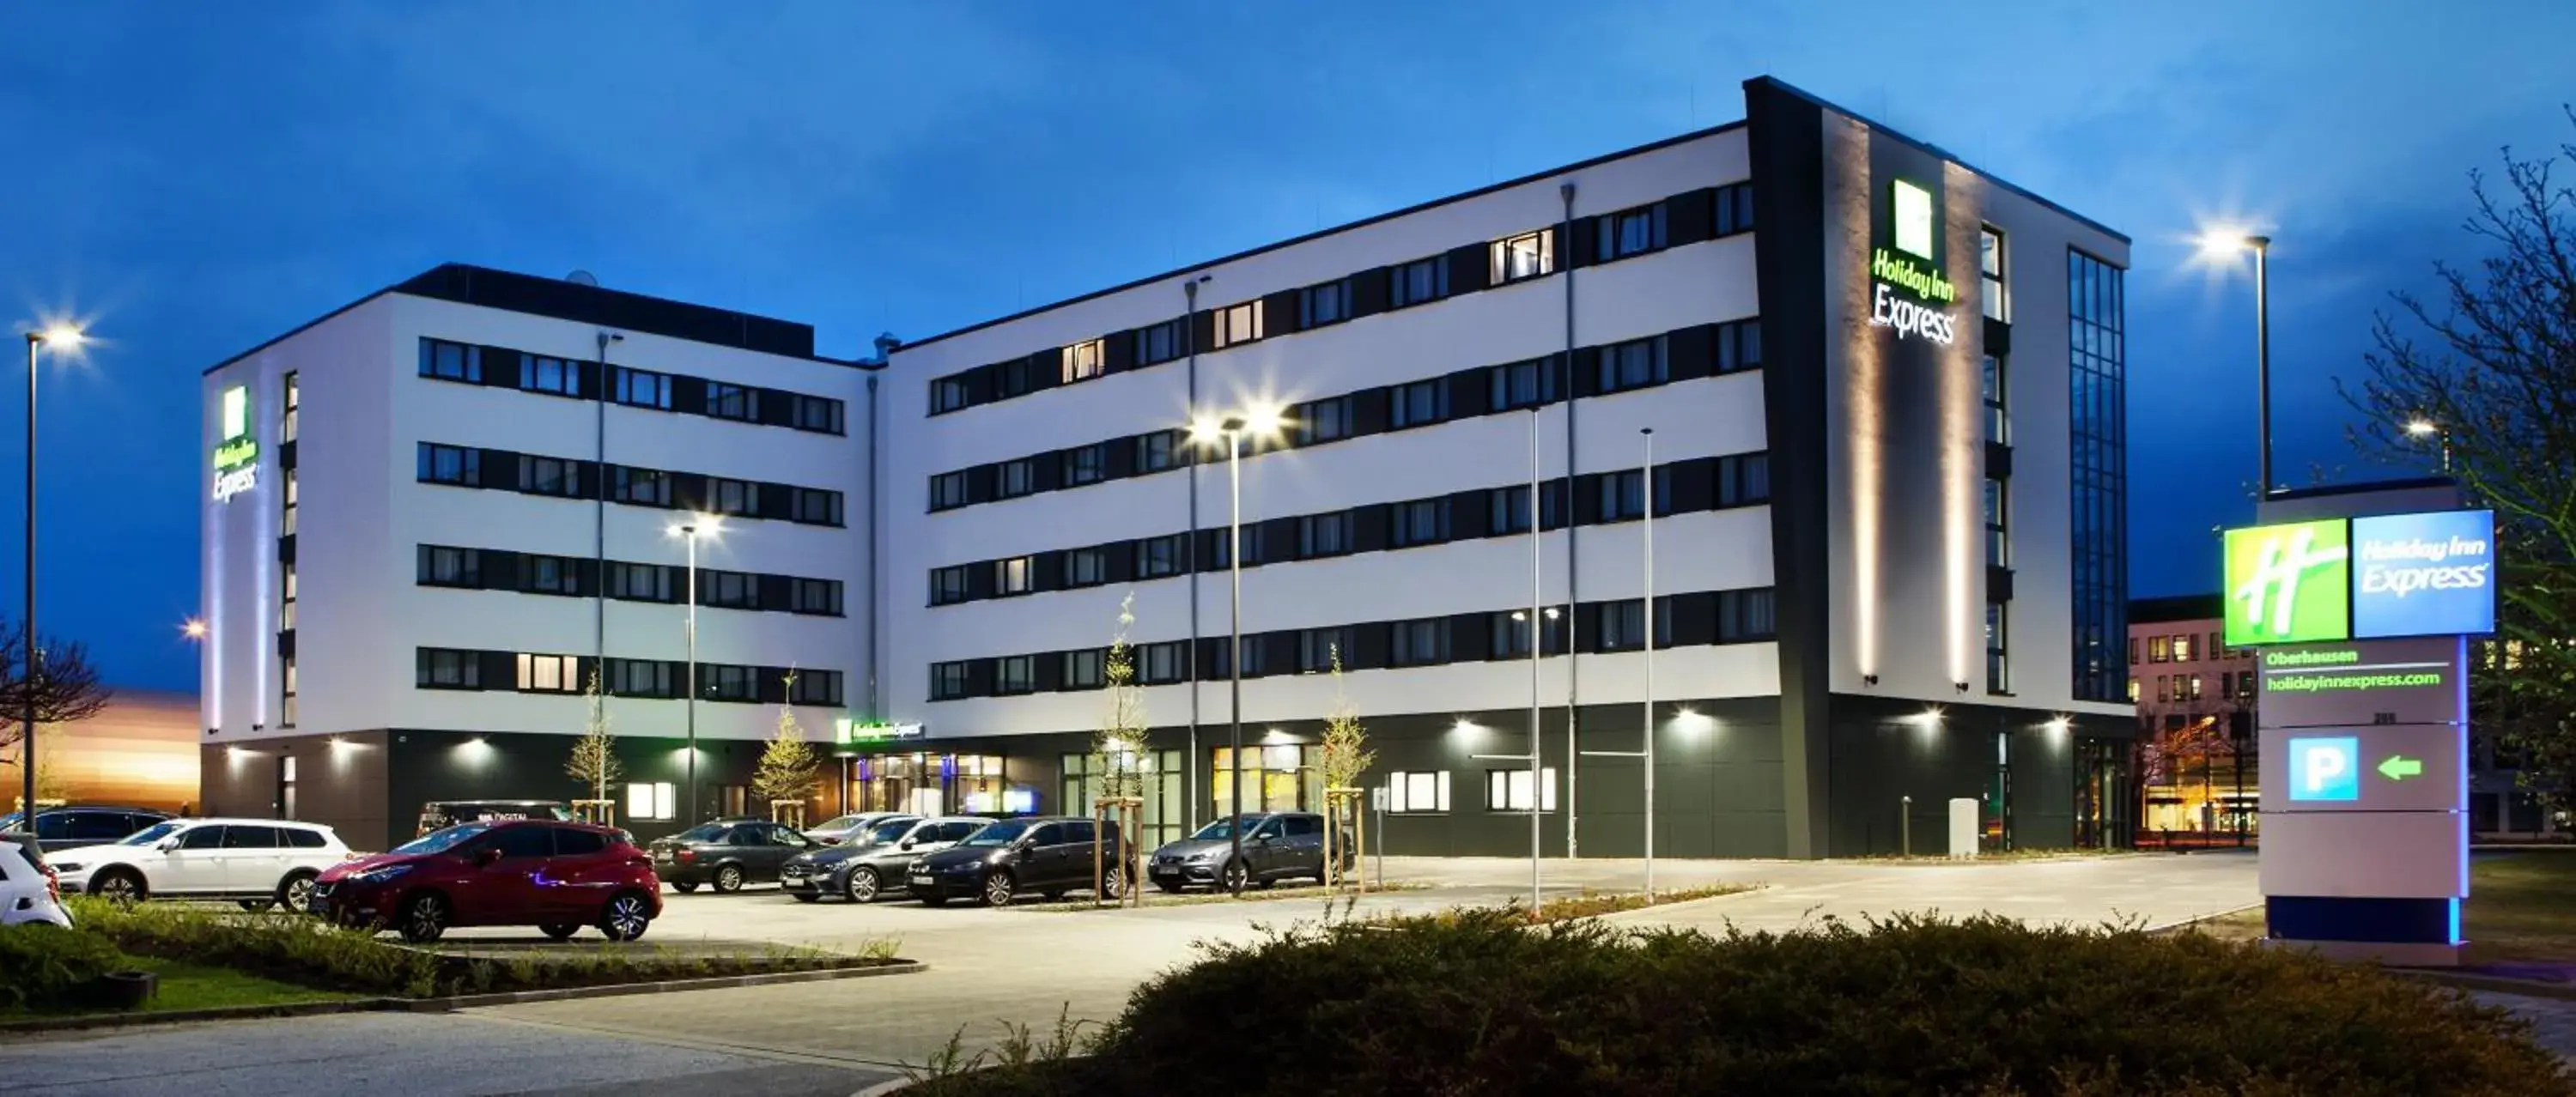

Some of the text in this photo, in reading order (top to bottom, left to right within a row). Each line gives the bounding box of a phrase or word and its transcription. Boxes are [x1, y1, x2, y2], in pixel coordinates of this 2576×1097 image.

[1873, 248, 1954, 302] Holiday Inn
[1872, 282, 1956, 344] Express
[2361, 535, 2486, 562] Holiday Inn
[2362, 562, 2489, 597] Express
[2266, 651, 2358, 666] Oberhausen
[2267, 674, 2440, 692] holidayinnexpress.com
[2306, 746, 2346, 791] P
